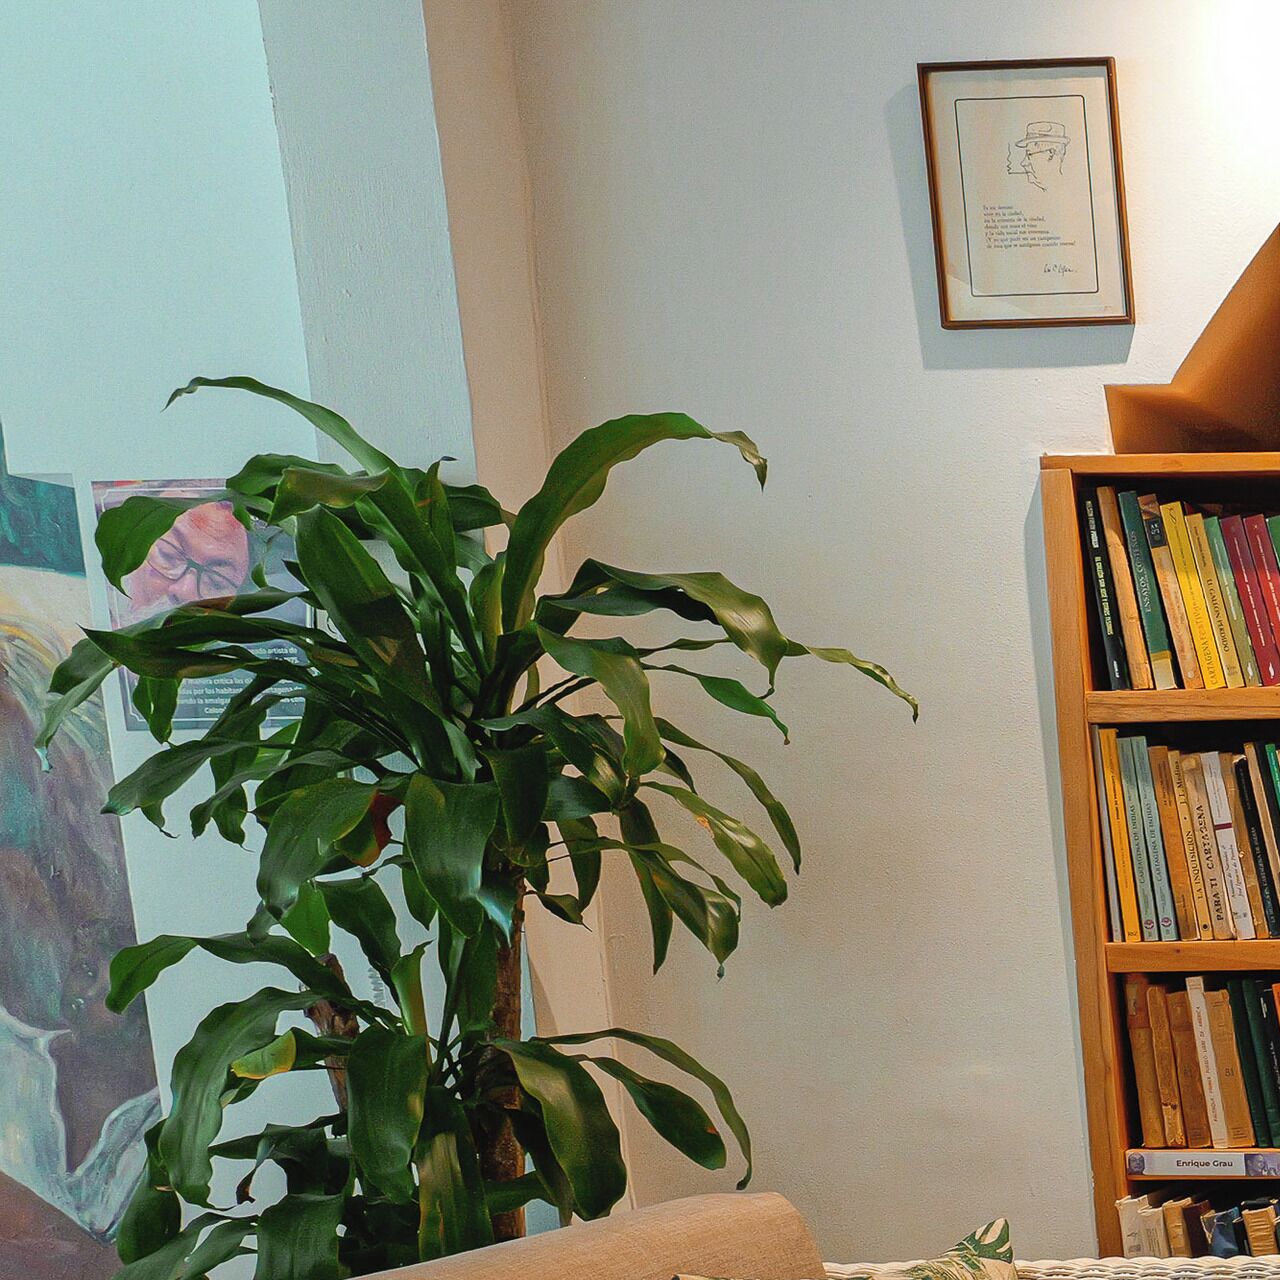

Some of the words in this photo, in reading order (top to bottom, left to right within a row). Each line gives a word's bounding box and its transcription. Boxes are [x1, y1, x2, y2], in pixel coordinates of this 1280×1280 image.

[1209, 877, 1218, 889] TI
[1211, 891, 1224, 921] PARA
[1176, 1158, 1211, 1169] Enrique
[1213, 1159, 1233, 1168] Grau
